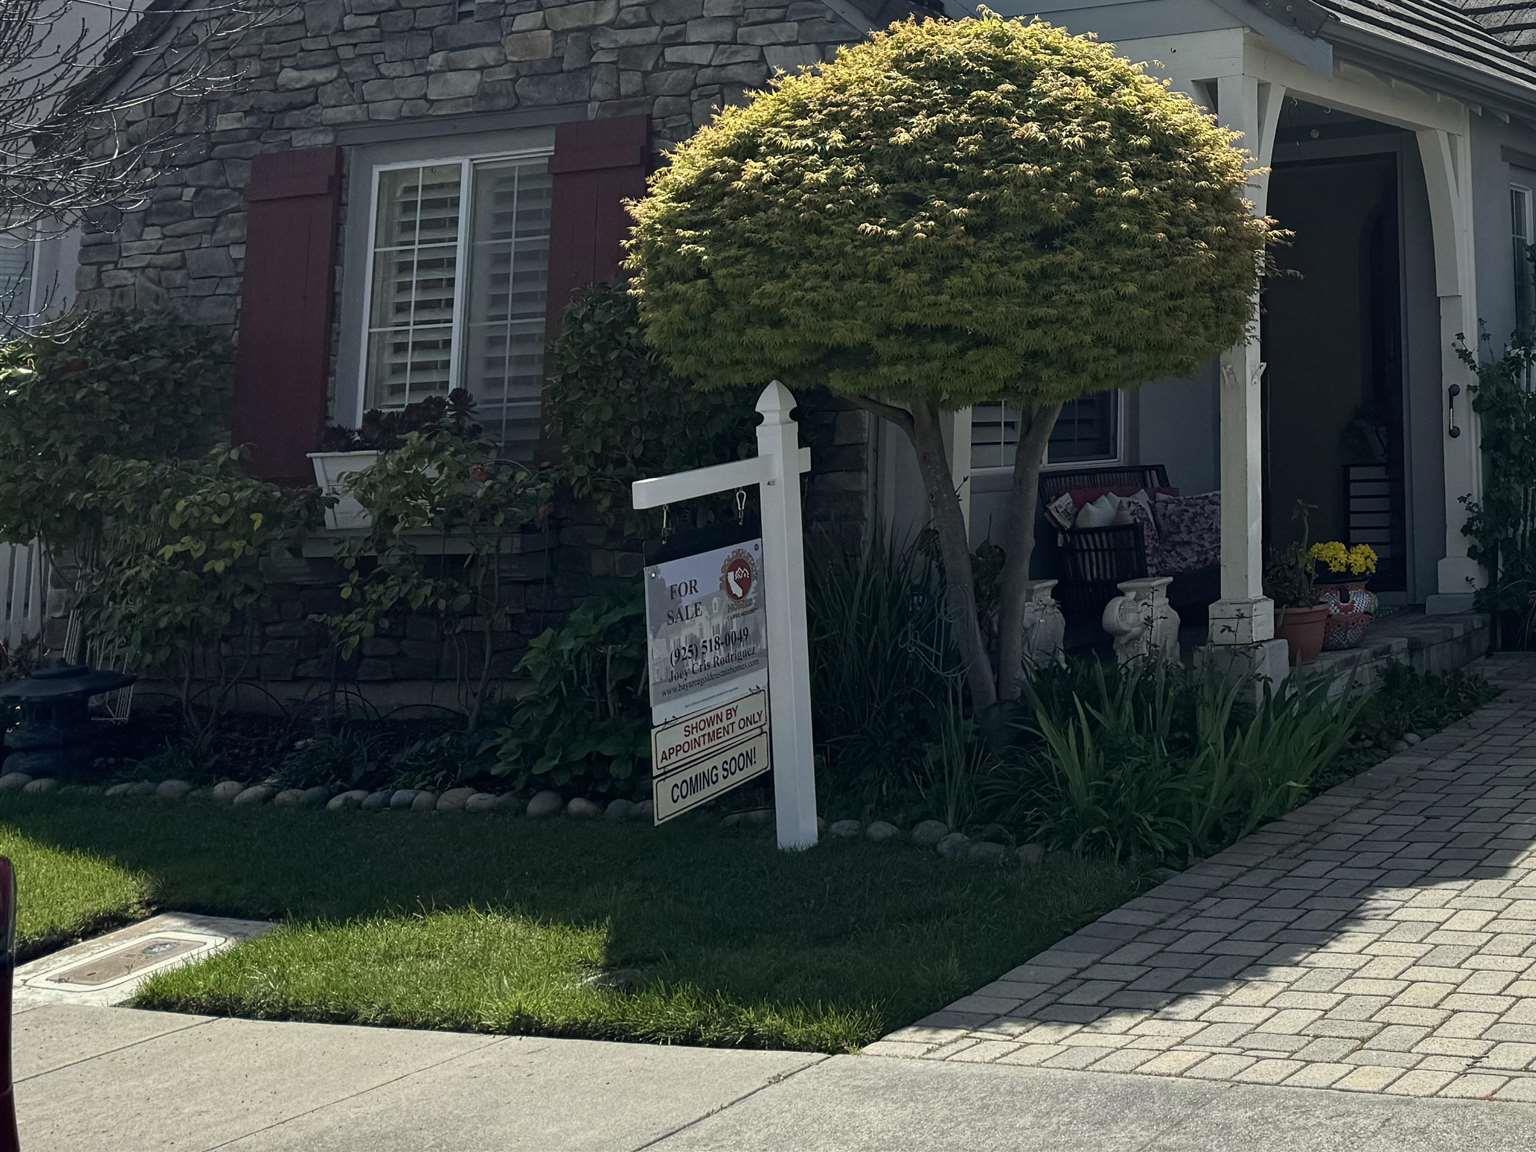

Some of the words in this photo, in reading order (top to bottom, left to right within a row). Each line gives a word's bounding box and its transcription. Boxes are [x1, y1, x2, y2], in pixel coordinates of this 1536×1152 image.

[670, 579, 699, 600] FOR
[666, 601, 703, 626] SALE
[670, 643, 698, 668] (925)
[701, 626, 749, 655] 518-0049
[669, 669, 689, 683] Joey
[691, 659, 711, 676] Cris
[660, 721, 736, 764] APPOINTMENT
[738, 710, 764, 730] ONLY
[683, 710, 724, 738] SHOWN
[726, 705, 739, 721] BY
[671, 765, 719, 804] COMING
[721, 746, 757, 780] SOON!
